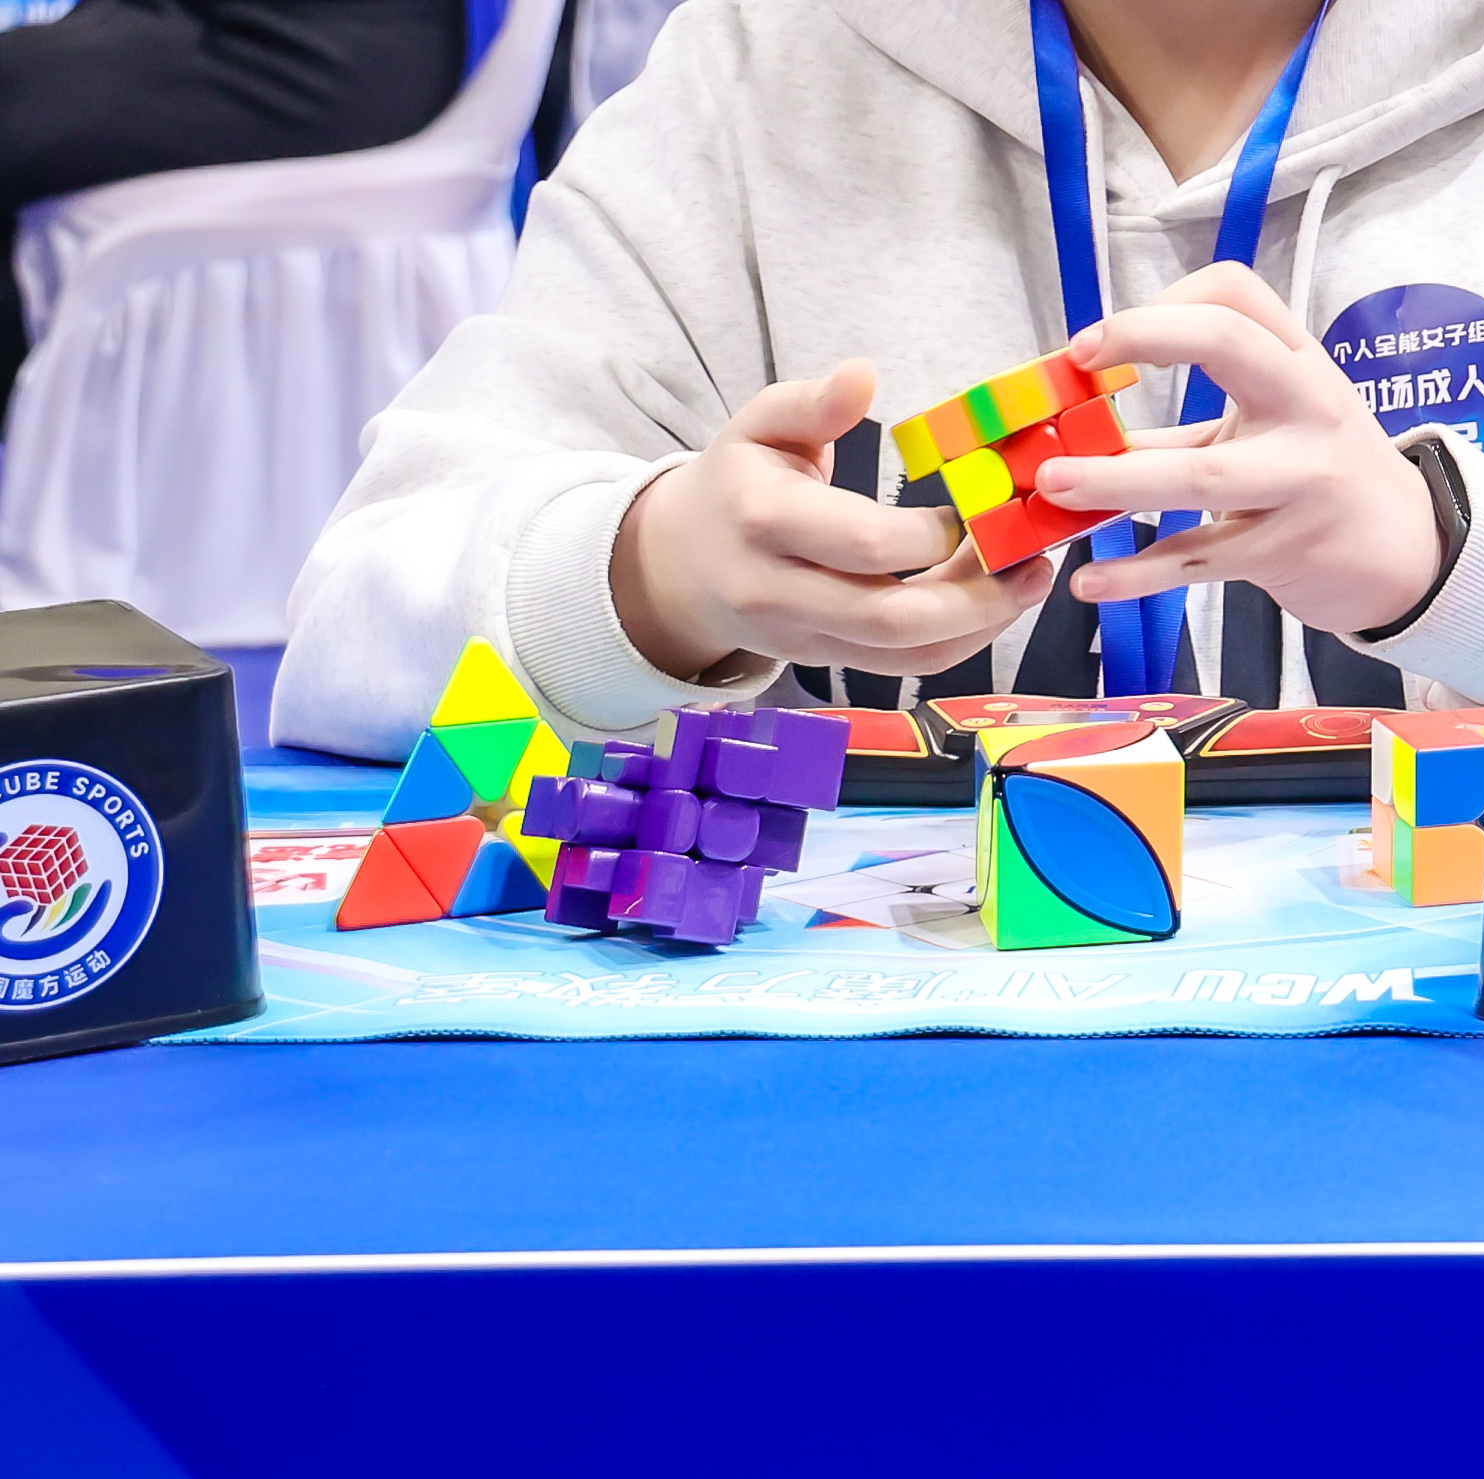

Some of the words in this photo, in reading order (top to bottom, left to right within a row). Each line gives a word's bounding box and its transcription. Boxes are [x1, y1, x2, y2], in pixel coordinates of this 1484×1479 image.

[0, 771, 61, 798] UBE
[72, 777, 149, 858] SPORTS
[1170, 966, 1434, 1006] WCU
